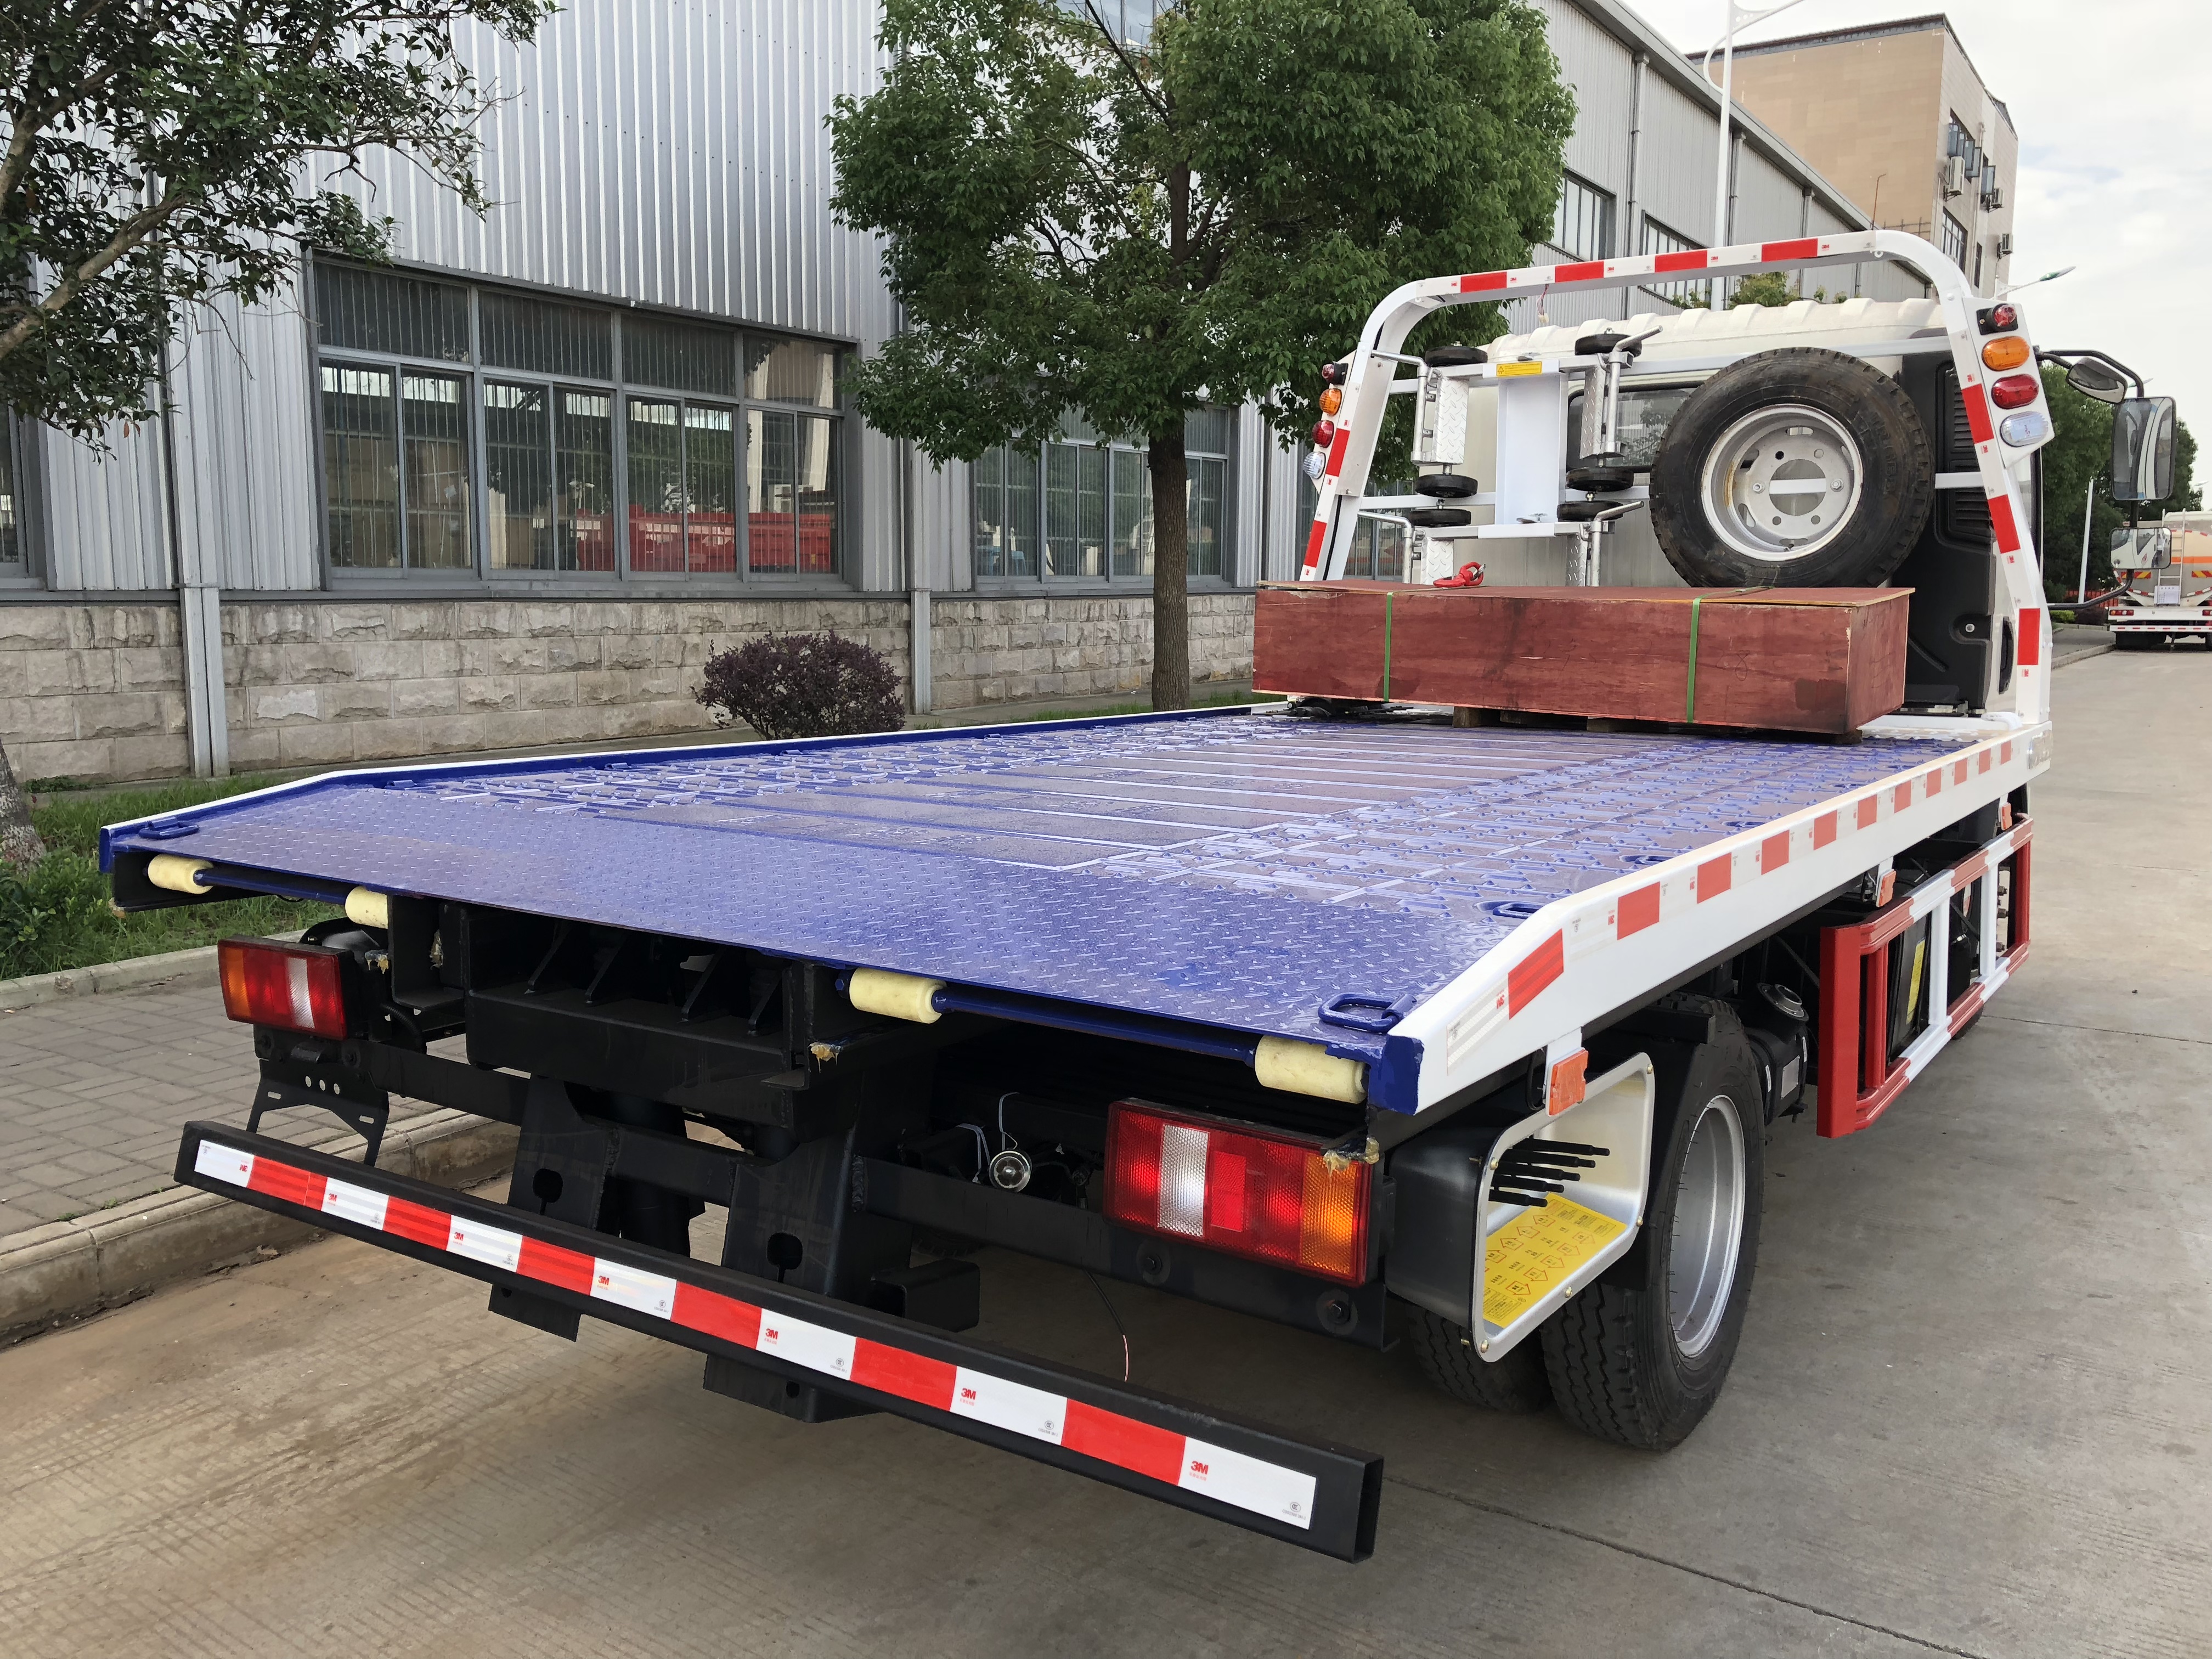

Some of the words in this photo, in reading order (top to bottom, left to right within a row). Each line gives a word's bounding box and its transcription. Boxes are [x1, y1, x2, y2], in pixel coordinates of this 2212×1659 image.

[328, 1193, 337, 1201] 3M
[454, 1232, 464, 1242] 3M
[598, 1276, 610, 1286] 3M
[766, 1328, 778, 1340] 3M
[961, 1388, 976, 1400] 3M
[1191, 1461, 1209, 1475] 3M
